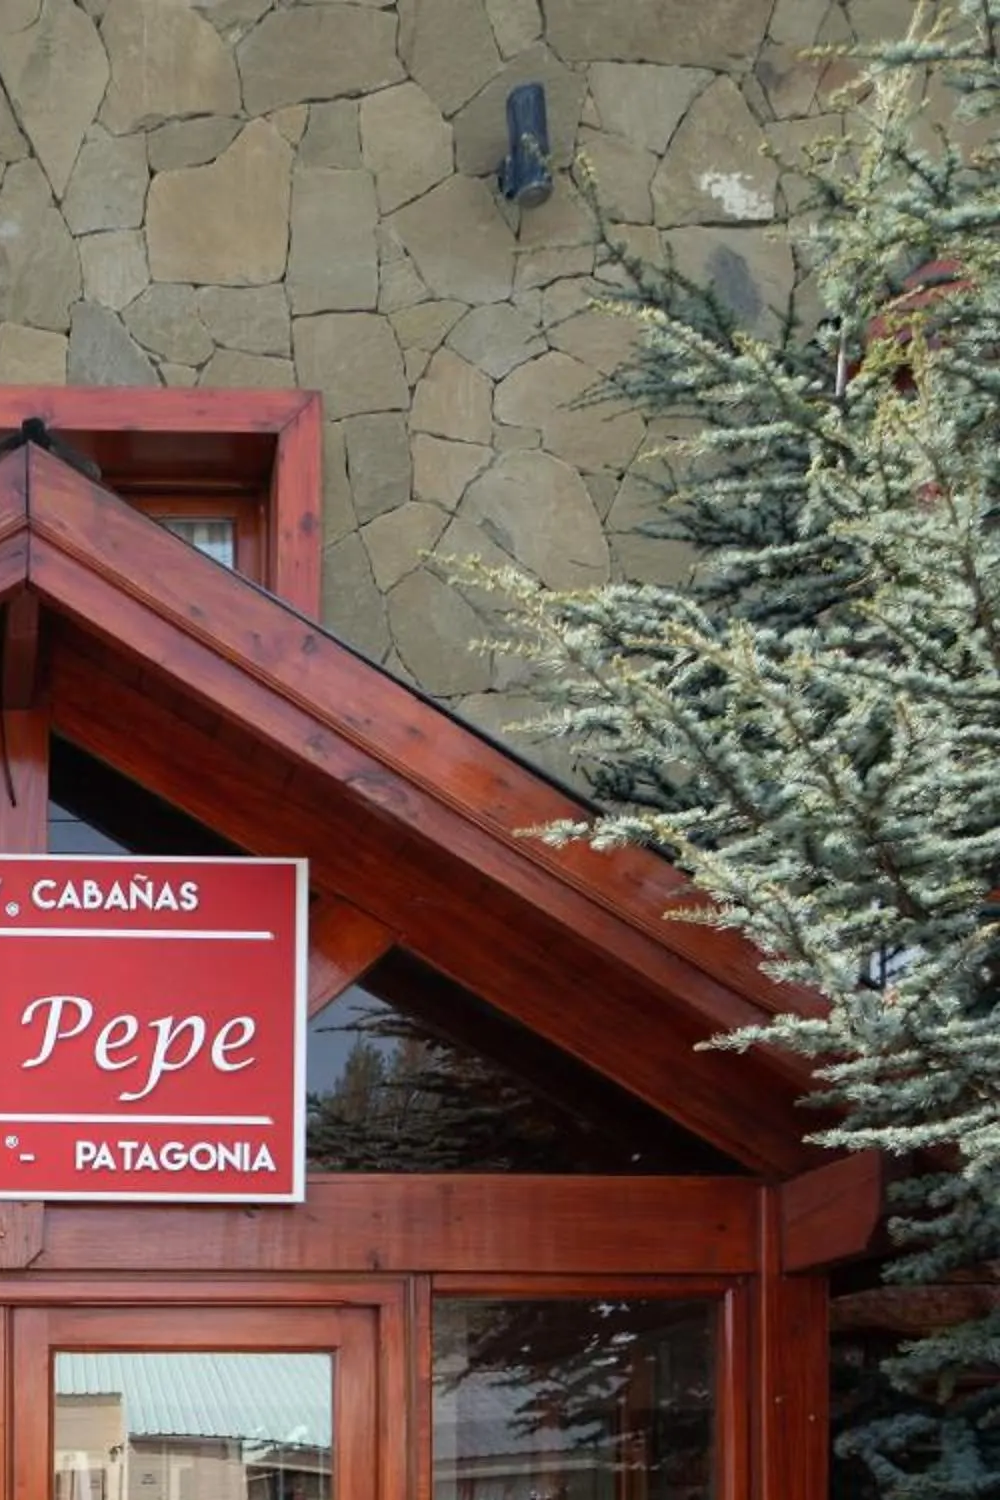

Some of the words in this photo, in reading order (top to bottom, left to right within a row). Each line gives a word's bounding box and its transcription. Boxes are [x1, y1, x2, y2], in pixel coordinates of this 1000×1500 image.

[31, 873, 199, 911] CABAÑAS
[20, 995, 257, 1102] Pepe
[75, 1140, 278, 1173] PATAGONIA
